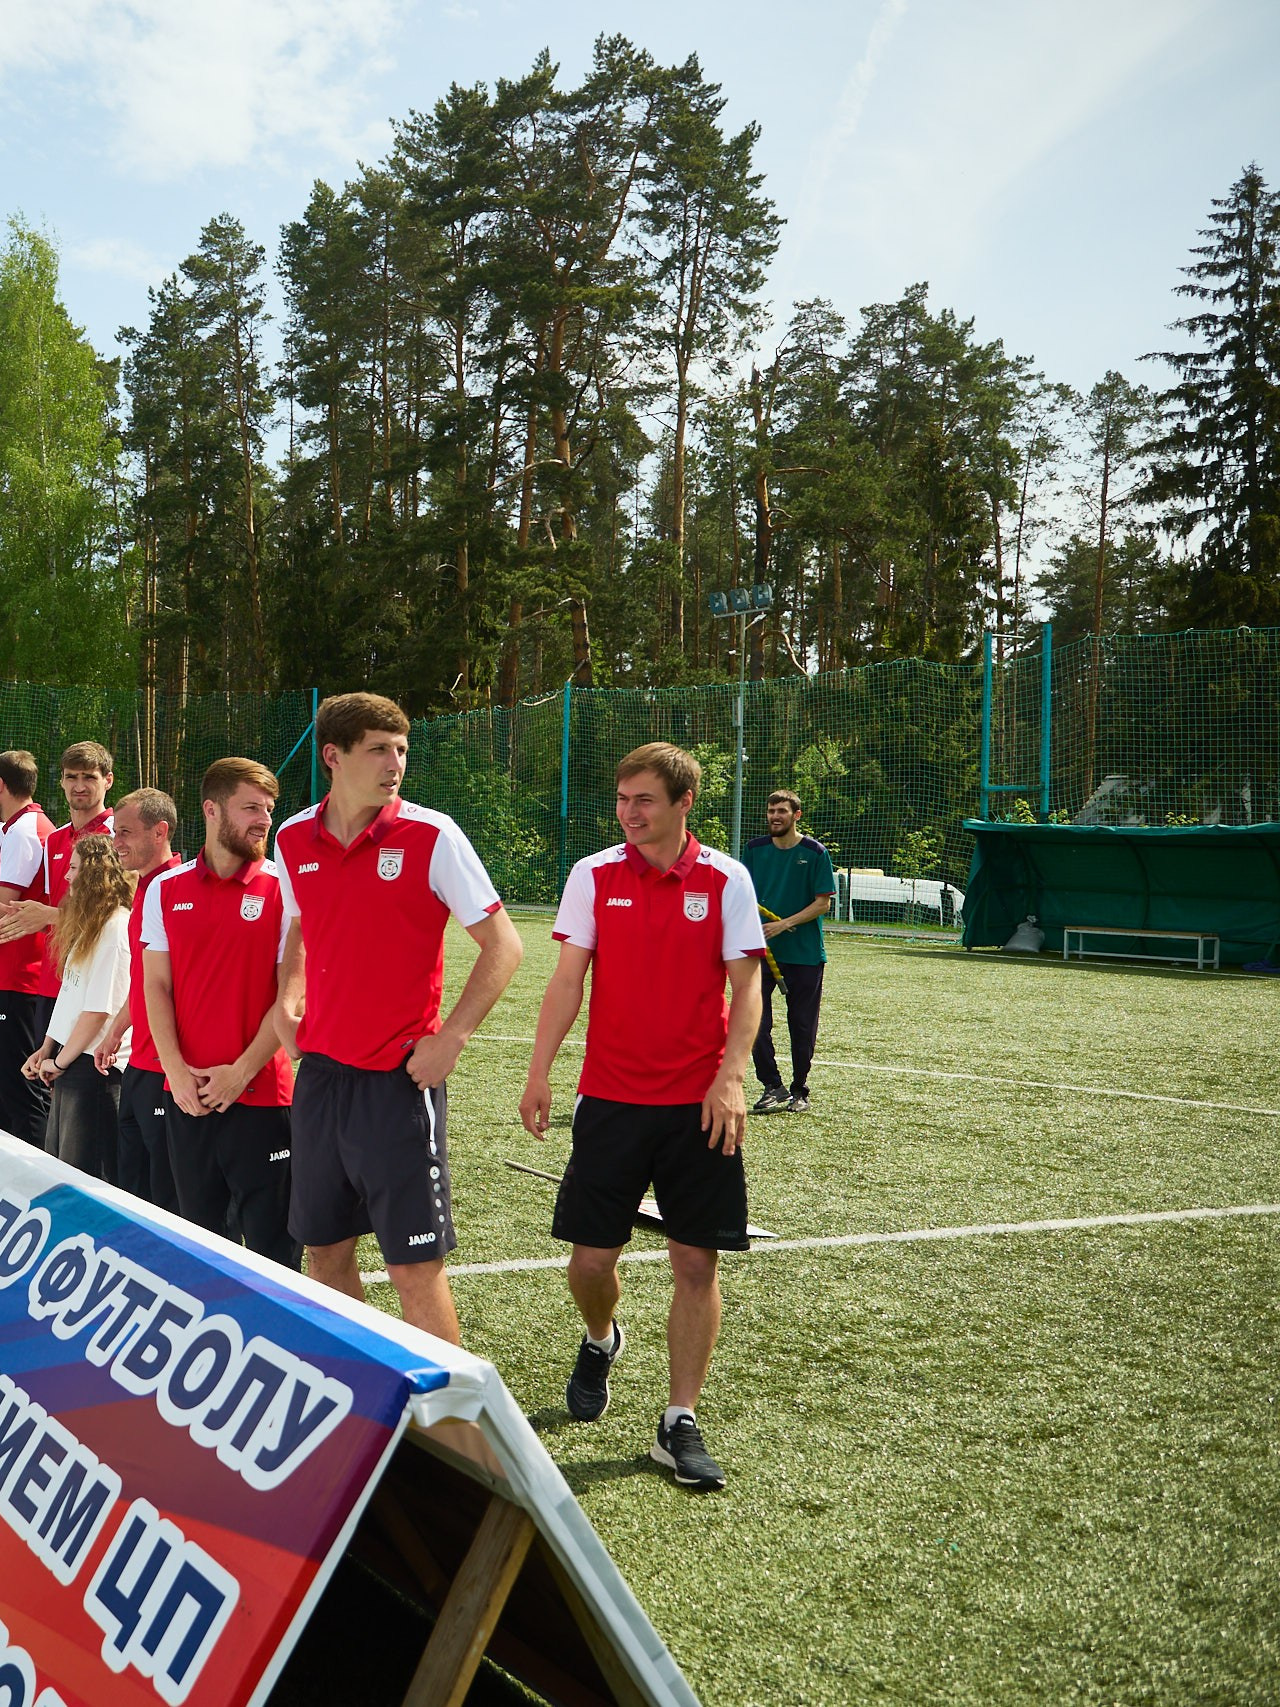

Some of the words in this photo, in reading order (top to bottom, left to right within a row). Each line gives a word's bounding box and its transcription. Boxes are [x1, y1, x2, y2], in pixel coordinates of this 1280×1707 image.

[298, 862, 320, 874] JAKO
[172, 903, 194, 912] JAKO
[606, 897, 632, 907] JAKO
[269, 1149, 291, 1162] JAKO
[408, 1232, 436, 1246] JAKO
[37, 1245, 339, 1473] ФУТБОЛУ
[95, 1514, 226, 1686] ЦП
